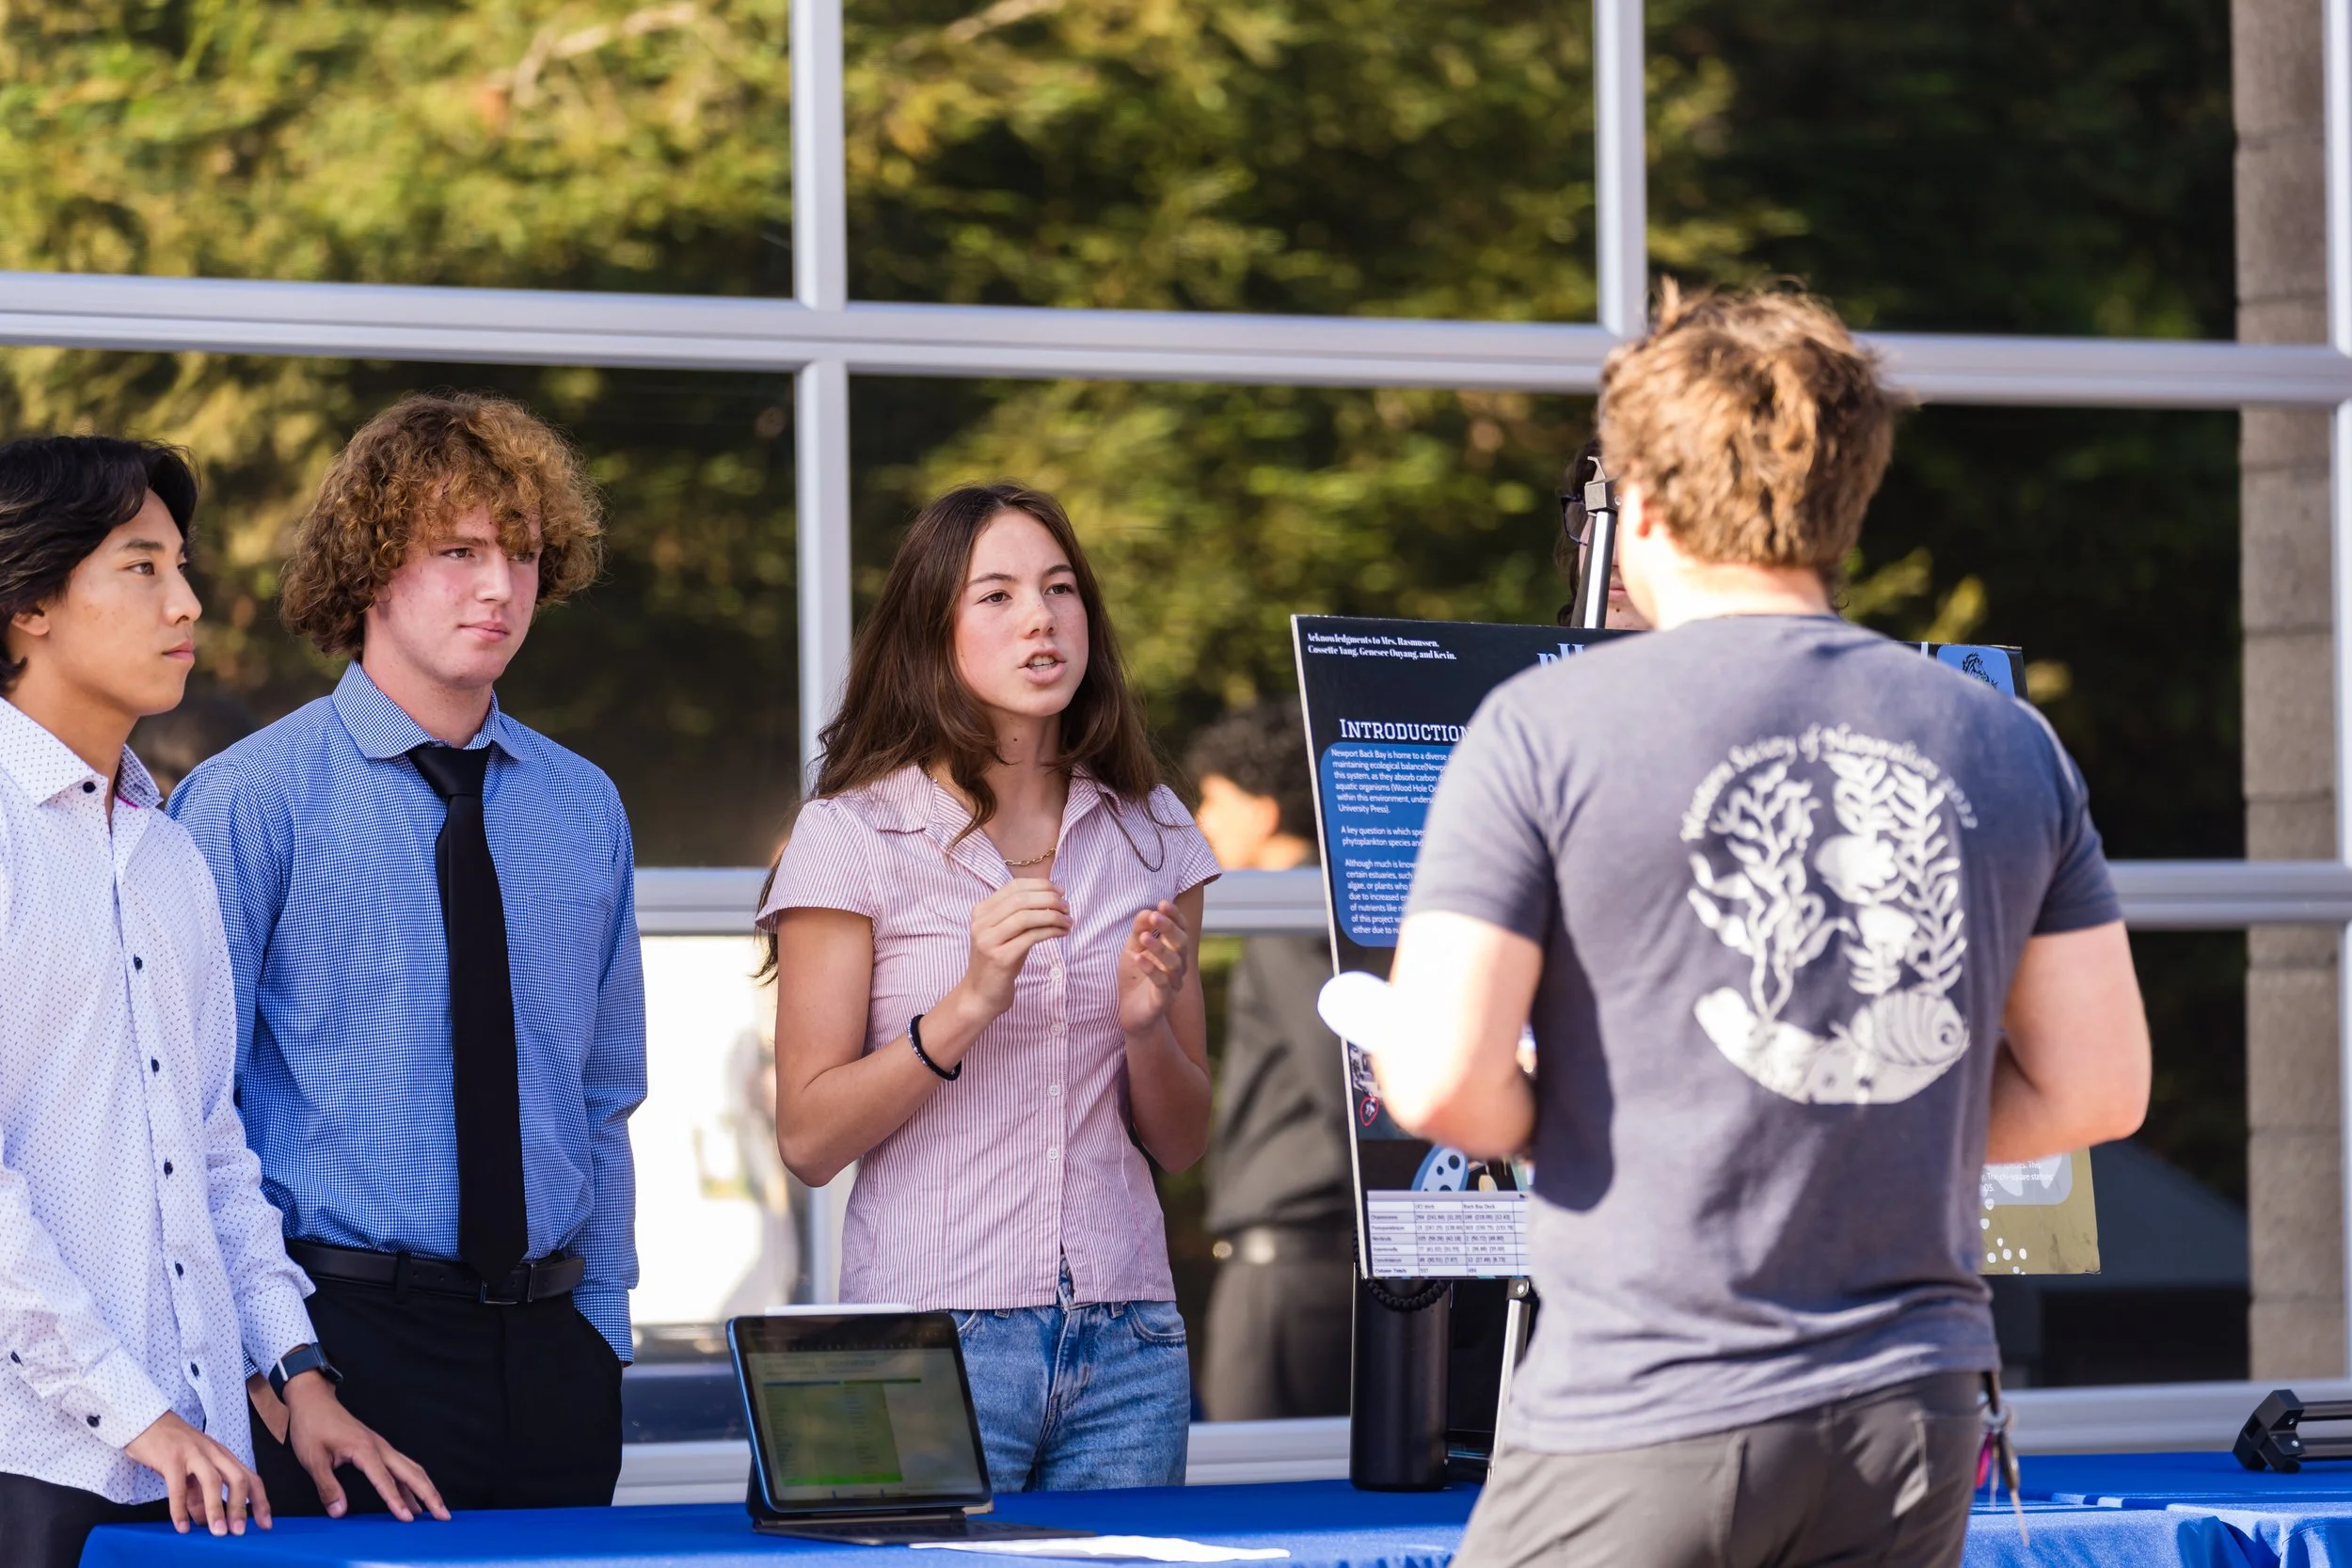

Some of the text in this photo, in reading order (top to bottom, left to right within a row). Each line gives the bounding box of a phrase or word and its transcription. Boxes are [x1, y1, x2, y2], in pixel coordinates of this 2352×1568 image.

[1308, 632, 1372, 645] Acknowledgments
[1381, 636, 1397, 645] Mrs.
[1419, 650, 1434, 658] and
[1798, 721, 1820, 764] of
[1330, 749, 1359, 758] Newport
[1359, 750, 1374, 758] Back
[1375, 751, 1387, 760] Bay
[1392, 751, 1411, 759] home
[1424, 752, 1447, 760] diverse
[1332, 762, 1370, 771] maintaining
[1370, 762, 1400, 771] ecological
[1379, 771, 1392, 782] they
[1336, 783, 1358, 792] aquatic
[1359, 784, 1391, 793] organisms
[1338, 804, 1369, 814] University
[1347, 826, 1358, 835] key
[1359, 827, 1386, 836] question
[1342, 837, 1388, 847] phytoplankton
[1389, 839, 1411, 848] species
[1345, 860, 1374, 869] Although
[1375, 882, 1393, 892] plants
[1359, 914, 1371, 923] this
[1372, 915, 1392, 924] project
[1372, 926, 1384, 934] due
